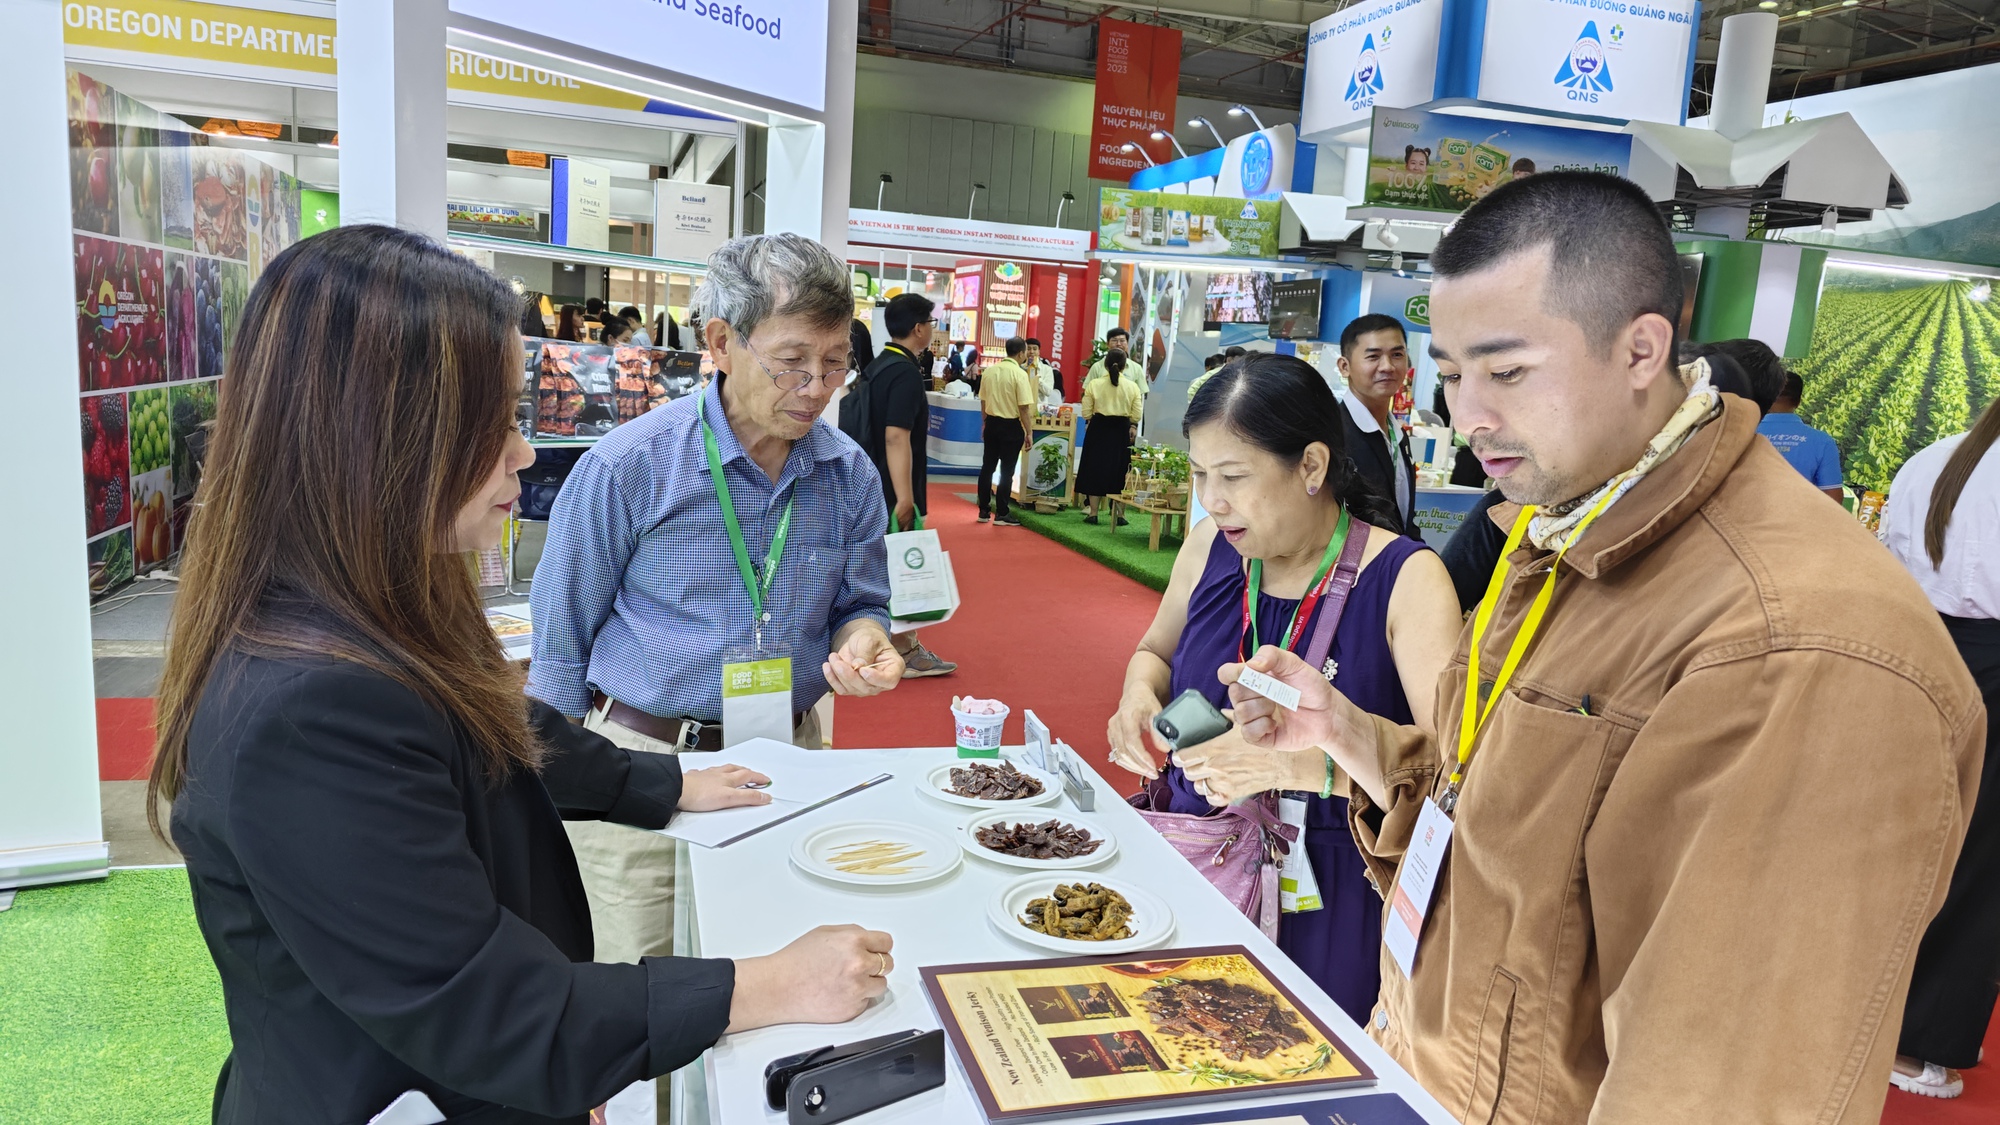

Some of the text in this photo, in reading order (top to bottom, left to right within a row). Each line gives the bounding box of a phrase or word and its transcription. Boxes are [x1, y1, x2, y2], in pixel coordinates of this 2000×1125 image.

[64, 3, 181, 40] OREGON
[694, 0, 781, 40] Seafood
[1328, 28, 1336, 37] TY
[1108, 46, 1128, 56] FOOD
[1106, 64, 1128, 74] 2023
[1567, 90, 1599, 104] QNS
[1352, 97, 1374, 111] QNS
[1392, 120, 1420, 132] vinasoy
[1387, 172, 1428, 192] 100%
[860, 220, 892, 229] VIETNAM
[936, 228, 962, 236] CHOSEN
[964, 230, 992, 238] INSTANT
[1022, 236, 1074, 246] MANUFACTURER
[1055, 272, 1068, 316] INSTANT
[1052, 316, 1065, 360] NOODLE
[732, 671, 752, 680] FOOD
[732, 678, 752, 686] EXPO
[968, 991, 1022, 1085] New Zealand Venison Jerky
[1032, 1055, 1043, 1064] One
[1026, 1063, 1037, 1072] New
[1037, 1064, 1050, 1074] Only
[1048, 1062, 1057, 1070] Low
